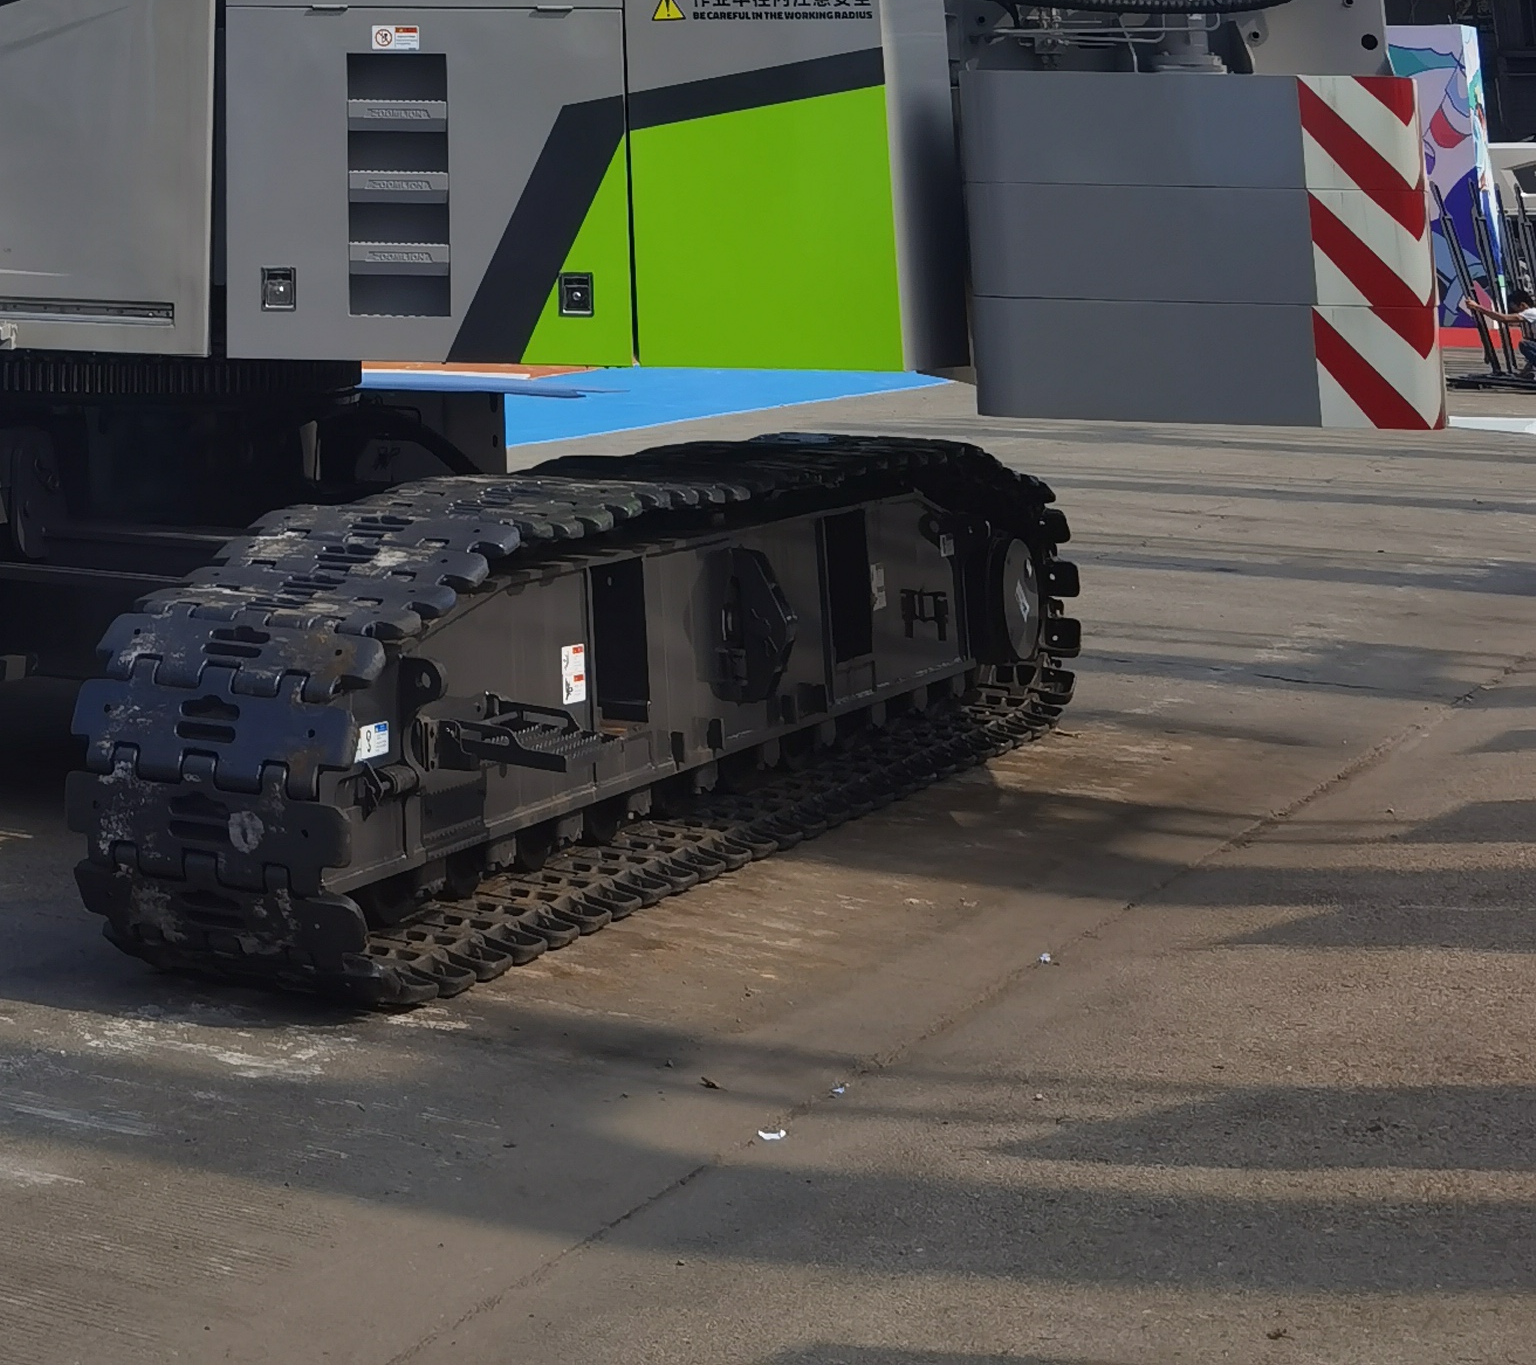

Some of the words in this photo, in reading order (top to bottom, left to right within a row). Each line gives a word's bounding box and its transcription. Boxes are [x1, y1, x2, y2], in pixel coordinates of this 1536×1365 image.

[692, 11, 706, 21] BE
[706, 11, 752, 21] CAREFUL
[751, 11, 763, 21] IN
[764, 11, 784, 21] THE
[784, 10, 834, 21] WORKING
[834, 10, 873, 20] RADIUS
